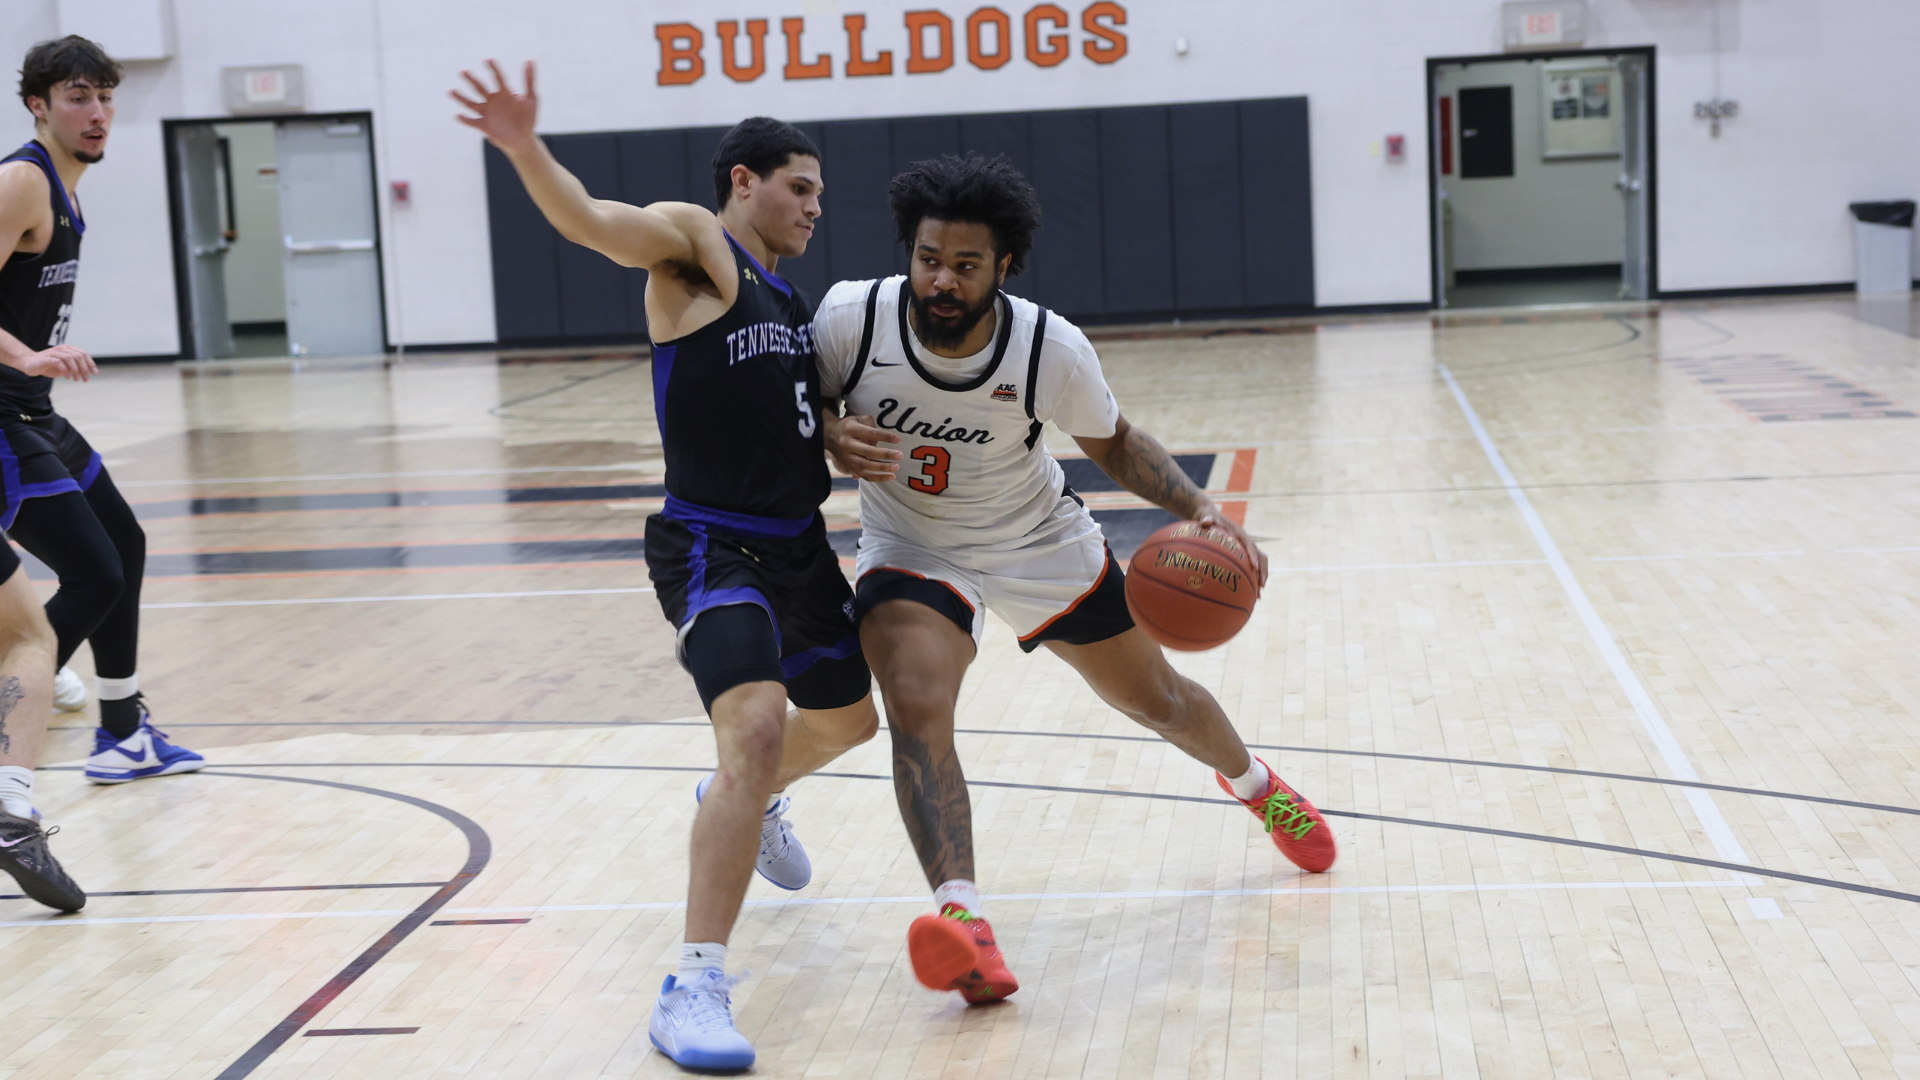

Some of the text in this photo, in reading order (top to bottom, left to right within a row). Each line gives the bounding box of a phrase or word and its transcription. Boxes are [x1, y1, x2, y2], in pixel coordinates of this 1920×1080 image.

[654, 2, 1128, 87] BULLDOGS
[794, 381, 816, 438] 5
[876, 398, 995, 444] Union
[907, 445, 951, 495] 3
[1154, 548, 1242, 593] SPALDING
